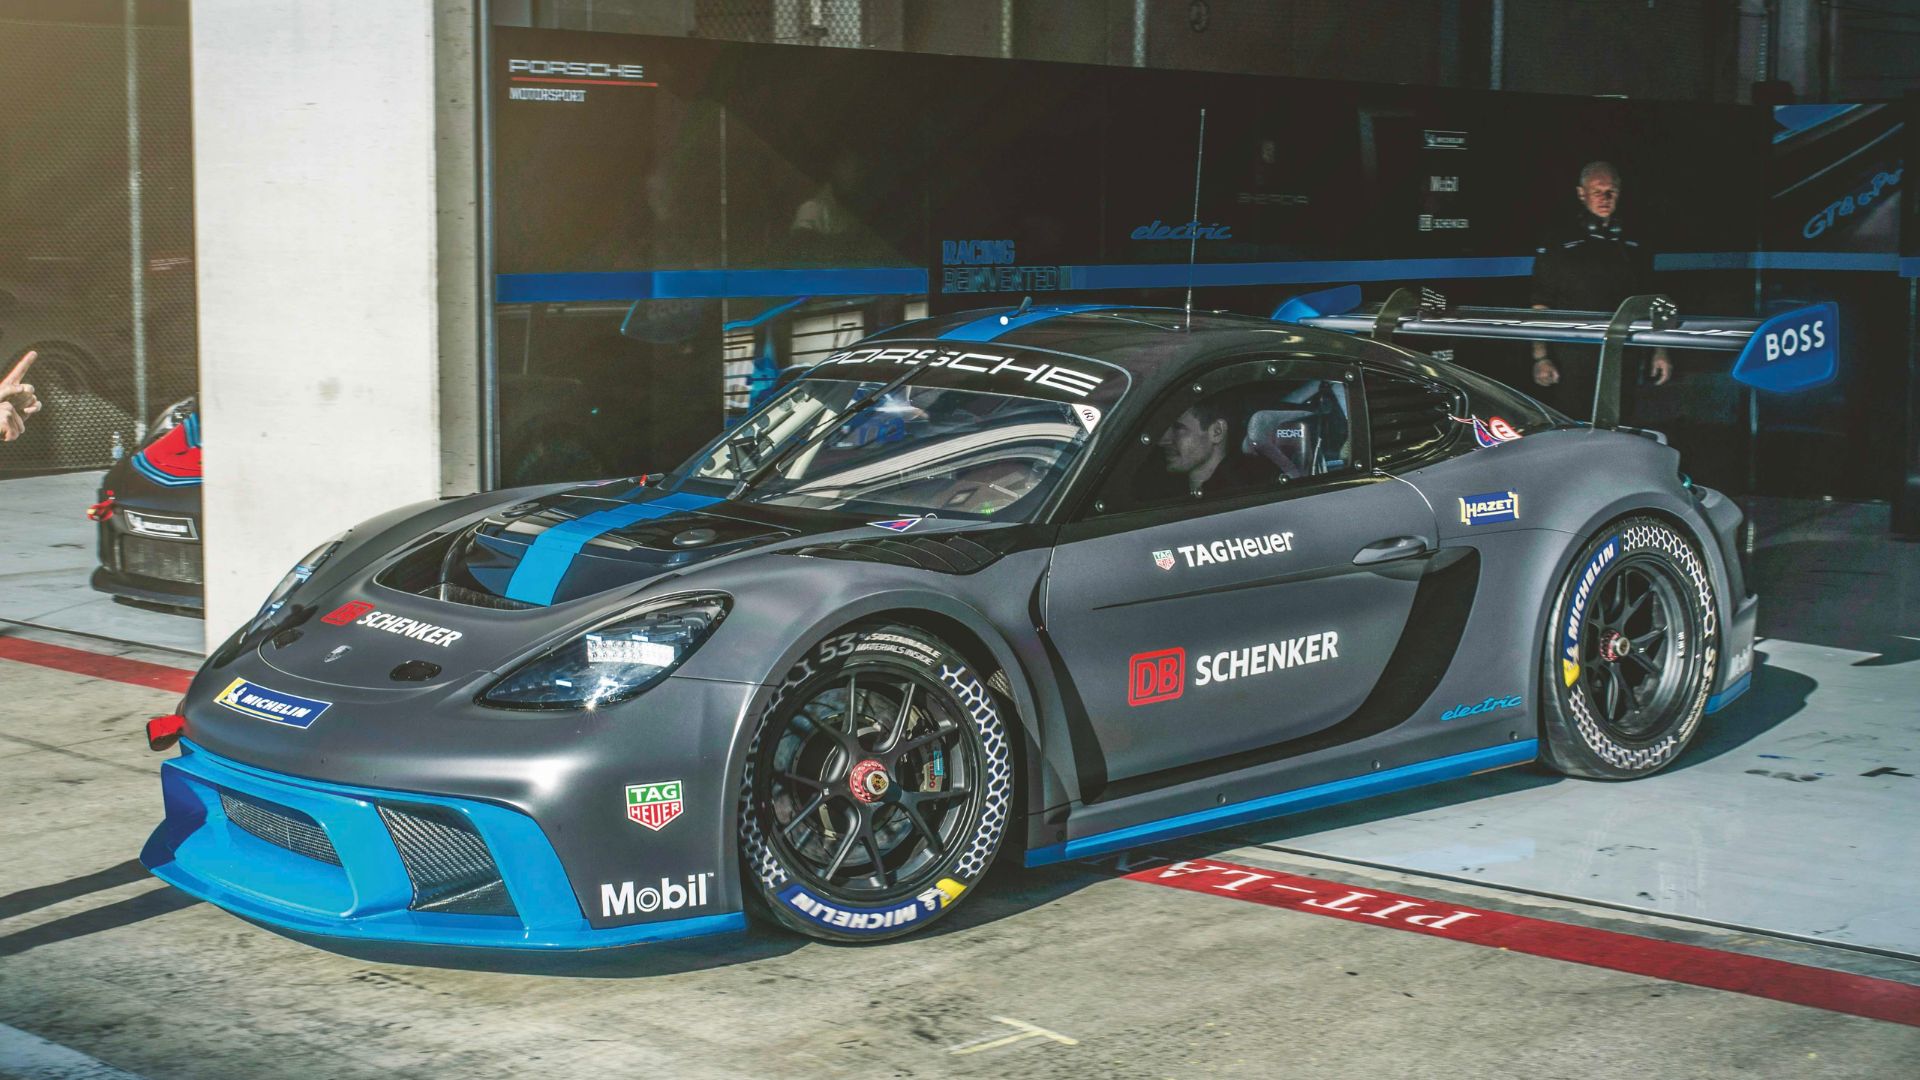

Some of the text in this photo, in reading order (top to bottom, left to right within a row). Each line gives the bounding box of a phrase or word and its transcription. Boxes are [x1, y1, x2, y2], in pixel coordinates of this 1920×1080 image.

[509, 59, 643, 79] PORSCHE
[509, 87, 586, 102] MOTORSPORT
[1130, 220, 1233, 240] electric
[942, 240, 1016, 265] RACING
[1764, 320, 1826, 362] BOSS
[1276, 429, 1304, 438] RECARO
[1466, 498, 1513, 518] HAZET
[1567, 543, 1615, 641] MICHELIN
[356, 611, 463, 648] SCHENKER
[1134, 630, 1339, 699] DB SCHENKER
[240, 692, 312, 718] MICHELIN
[1440, 695, 1522, 721] electric
[630, 784, 677, 802] TAG
[631, 802, 680, 828] HEUER
[600, 873, 707, 917] Mobil
[790, 892, 918, 929] MICHELIN
